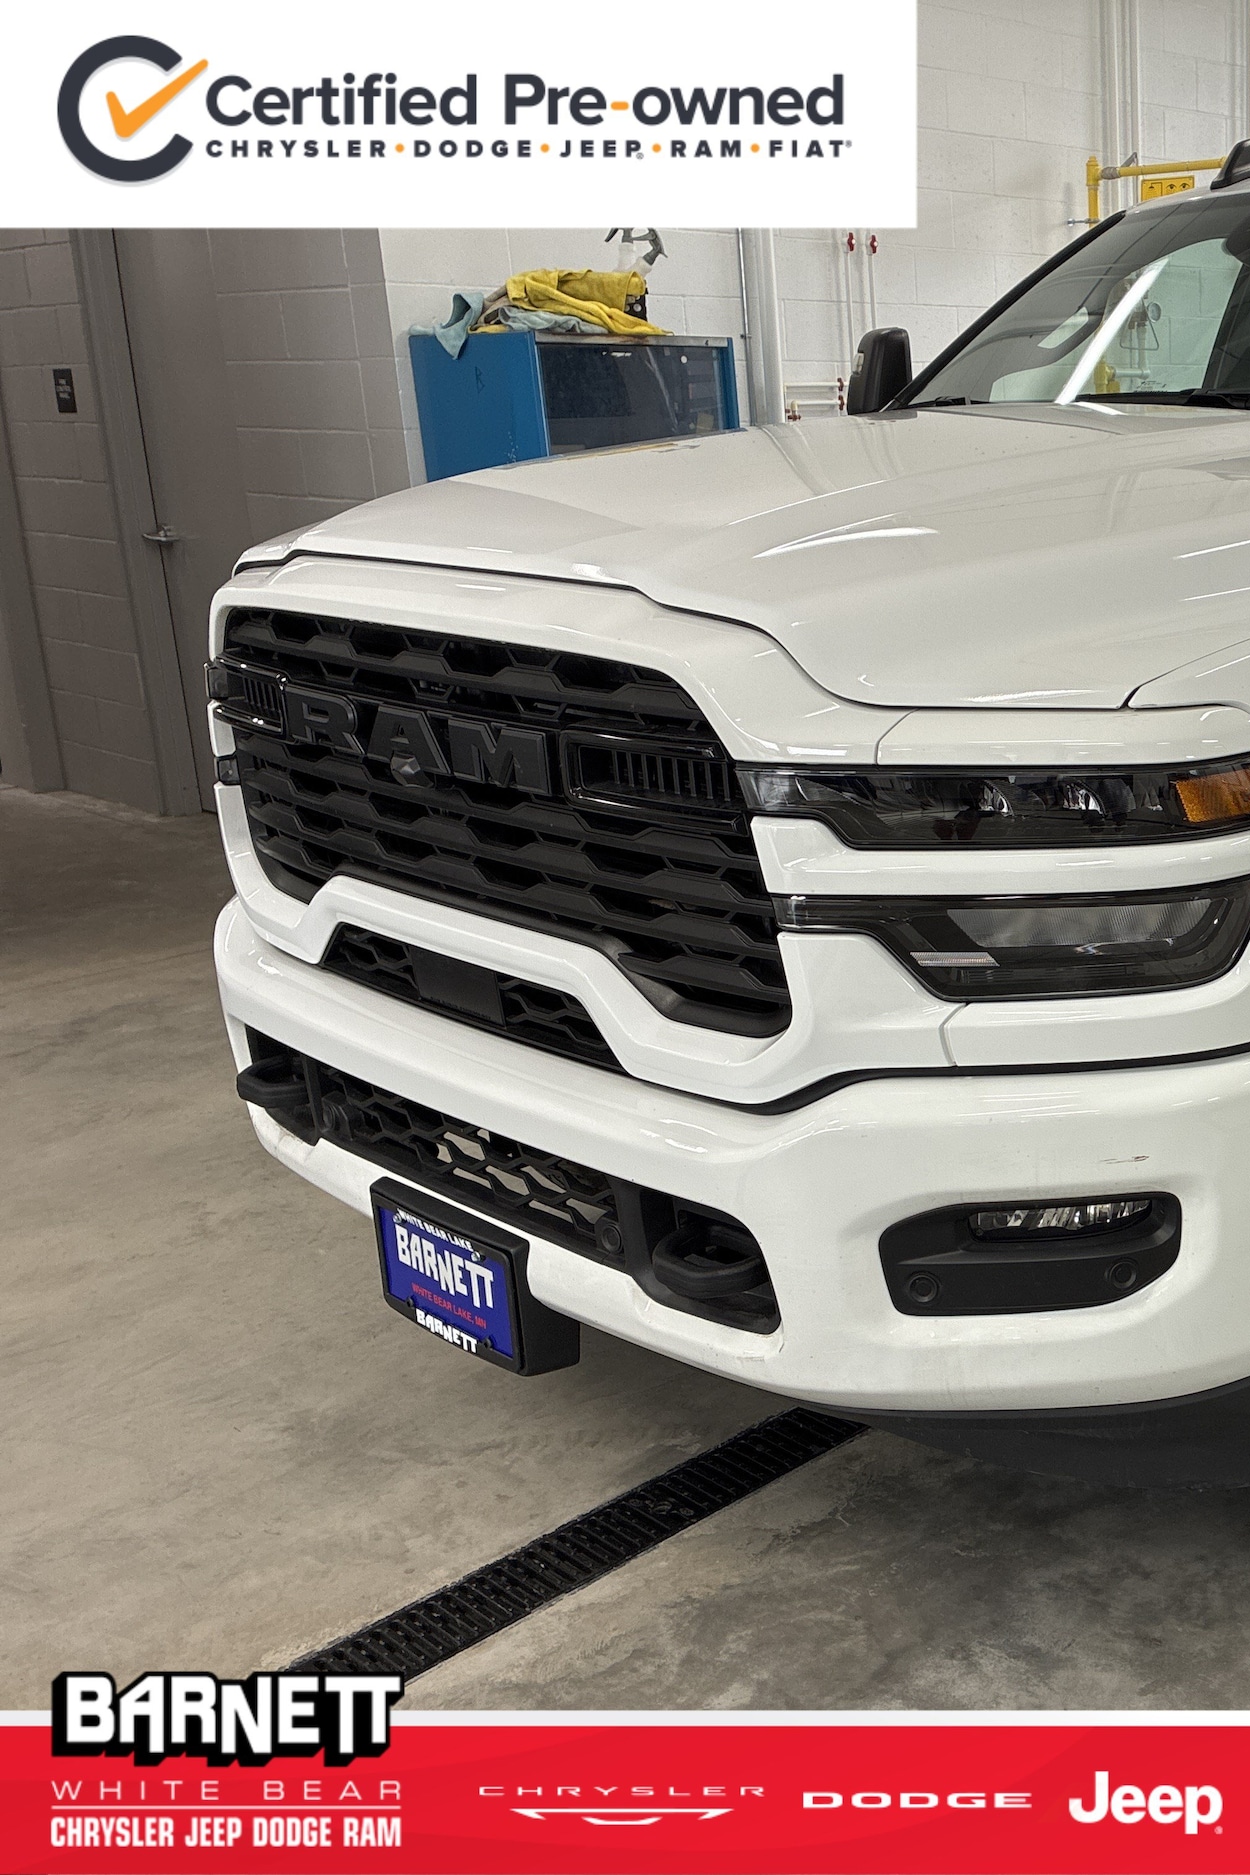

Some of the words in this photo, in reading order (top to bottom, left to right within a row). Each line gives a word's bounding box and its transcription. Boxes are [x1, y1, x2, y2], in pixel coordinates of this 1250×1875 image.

[284, 685, 551, 796] RAM
[397, 1208, 425, 1231] WHITE
[423, 1221, 450, 1242] BEAR
[447, 1232, 474, 1252] LAKE
[395, 1224, 494, 1309] BARNETT
[411, 1282, 434, 1301] WHITE
[433, 1294, 454, 1312] BEAR
[415, 1308, 478, 1354] BARNETT
